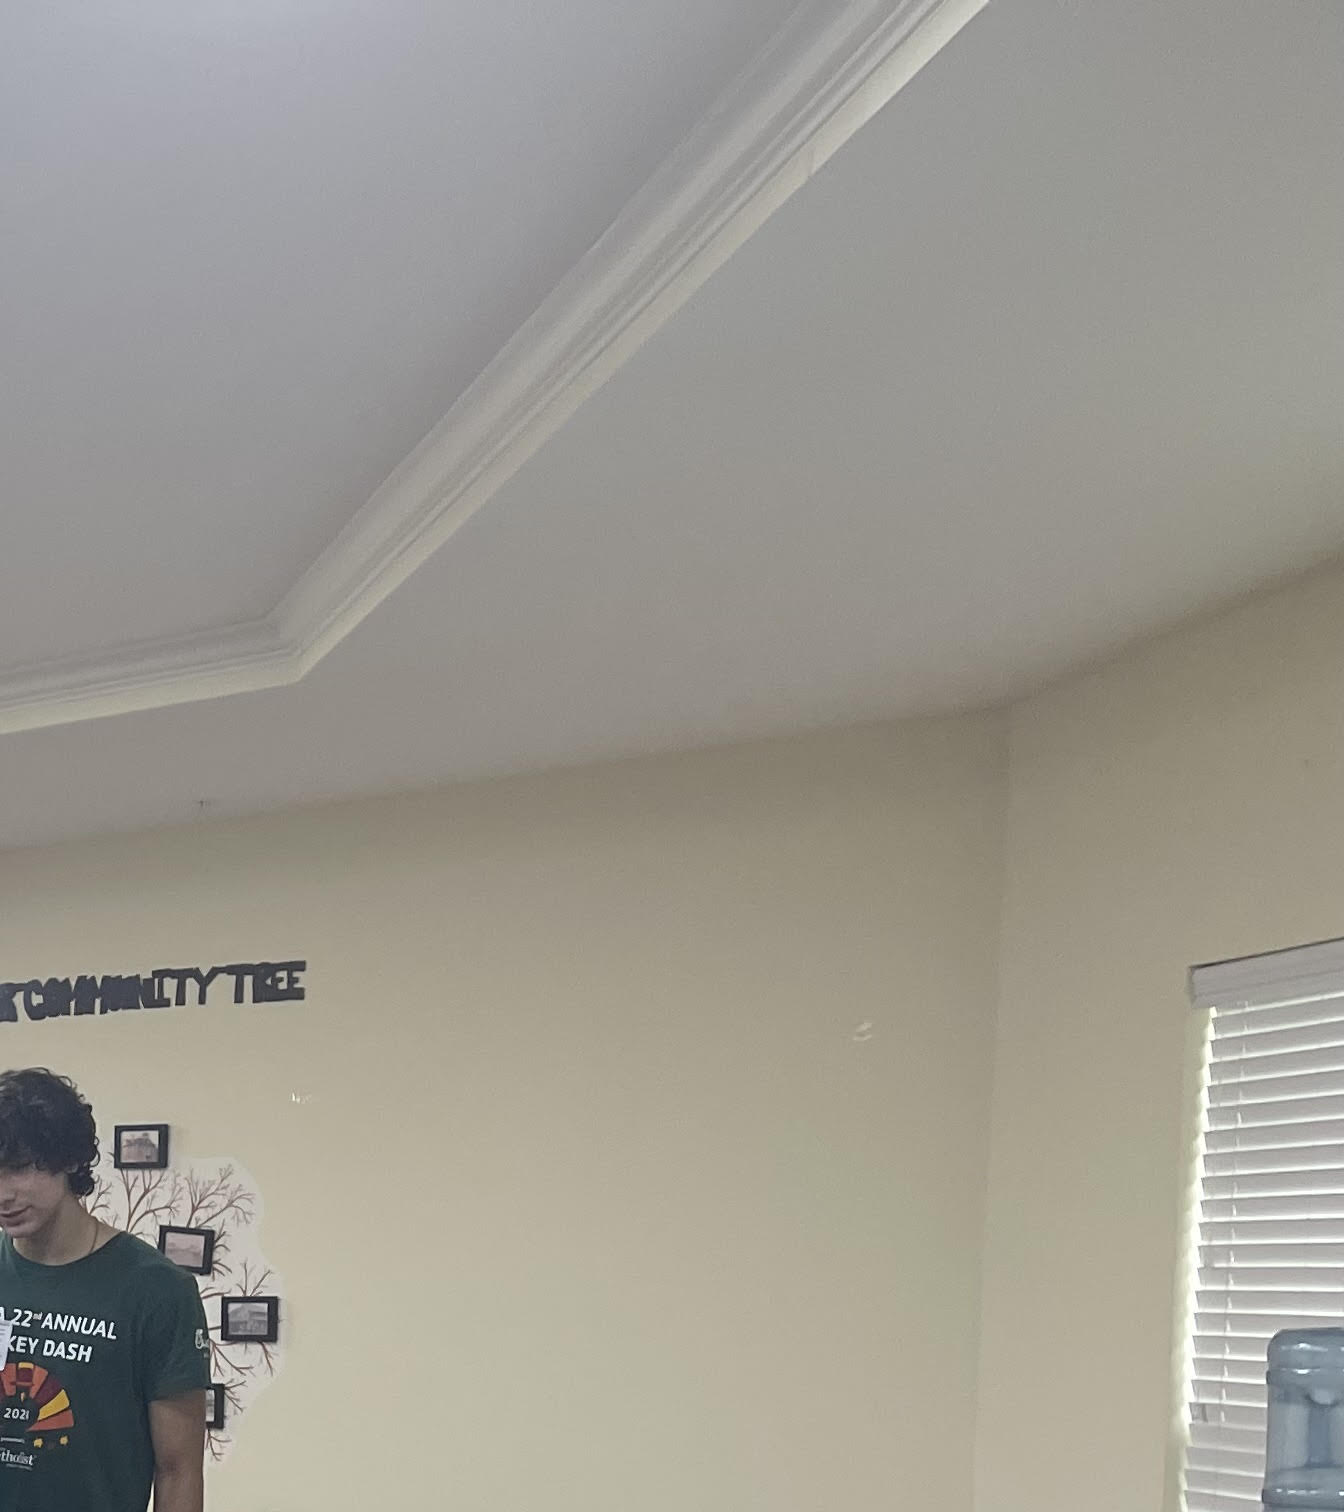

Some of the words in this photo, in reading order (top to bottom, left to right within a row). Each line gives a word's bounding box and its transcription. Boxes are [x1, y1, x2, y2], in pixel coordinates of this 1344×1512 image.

[219, 960, 306, 1004] TREE
[41, 1312, 117, 1340] ANNUAL
[42, 1339, 93, 1363] DASH
[3, 1407, 30, 1421] 2021
